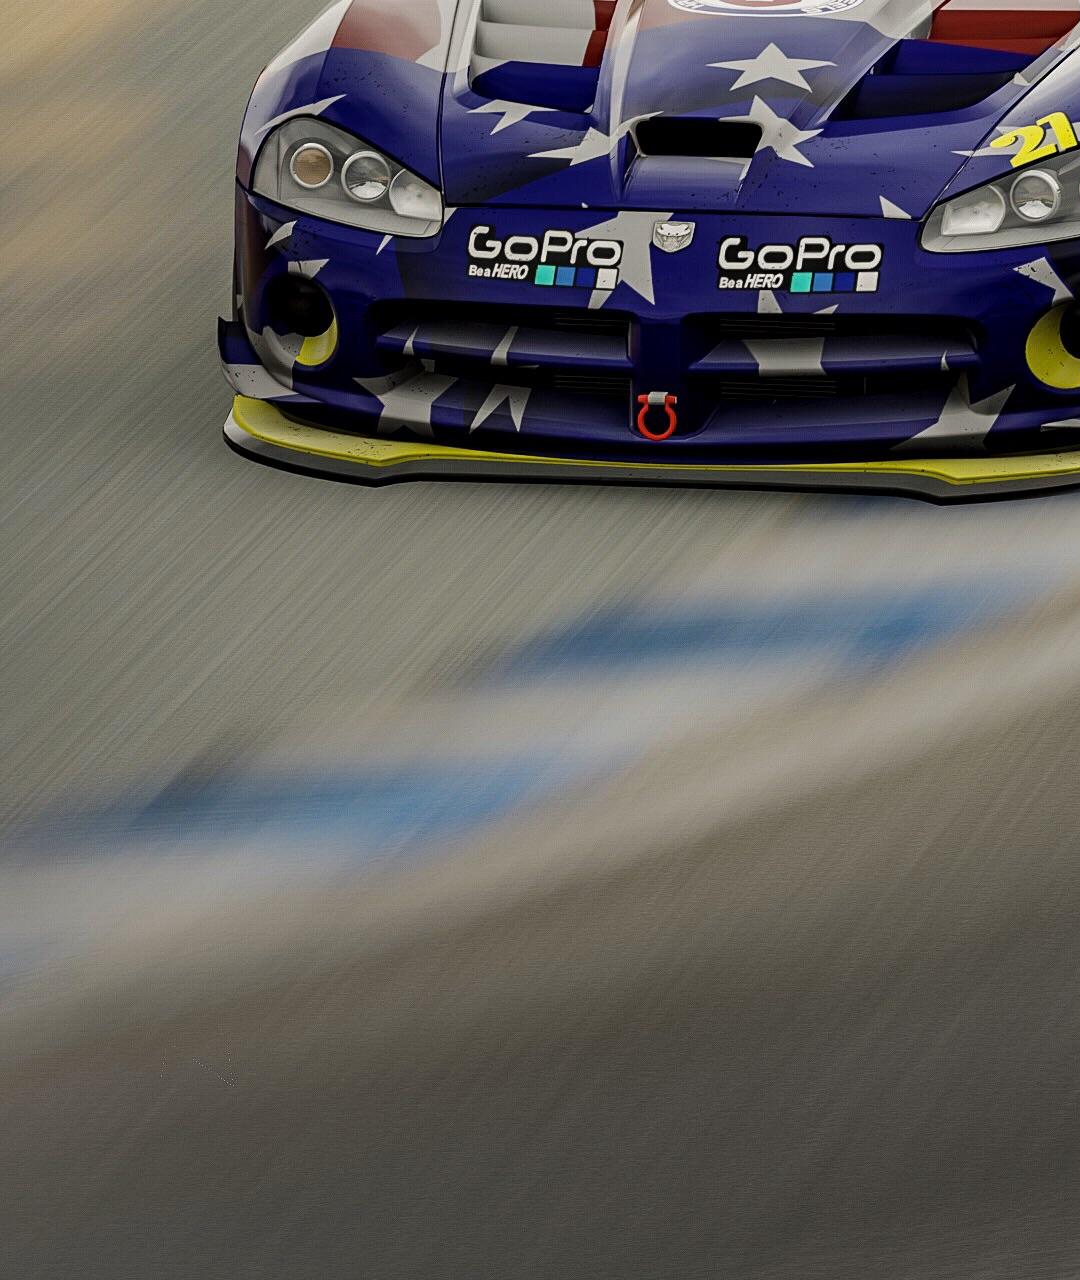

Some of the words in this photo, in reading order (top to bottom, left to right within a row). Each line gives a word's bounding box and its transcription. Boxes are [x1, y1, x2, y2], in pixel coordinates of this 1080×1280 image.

[989, 111, 1079, 169] 21
[468, 225, 622, 266] GoPro
[718, 237, 882, 270] GoPro
[492, 262, 529, 280] HERO
[744, 273, 784, 289] HERO
